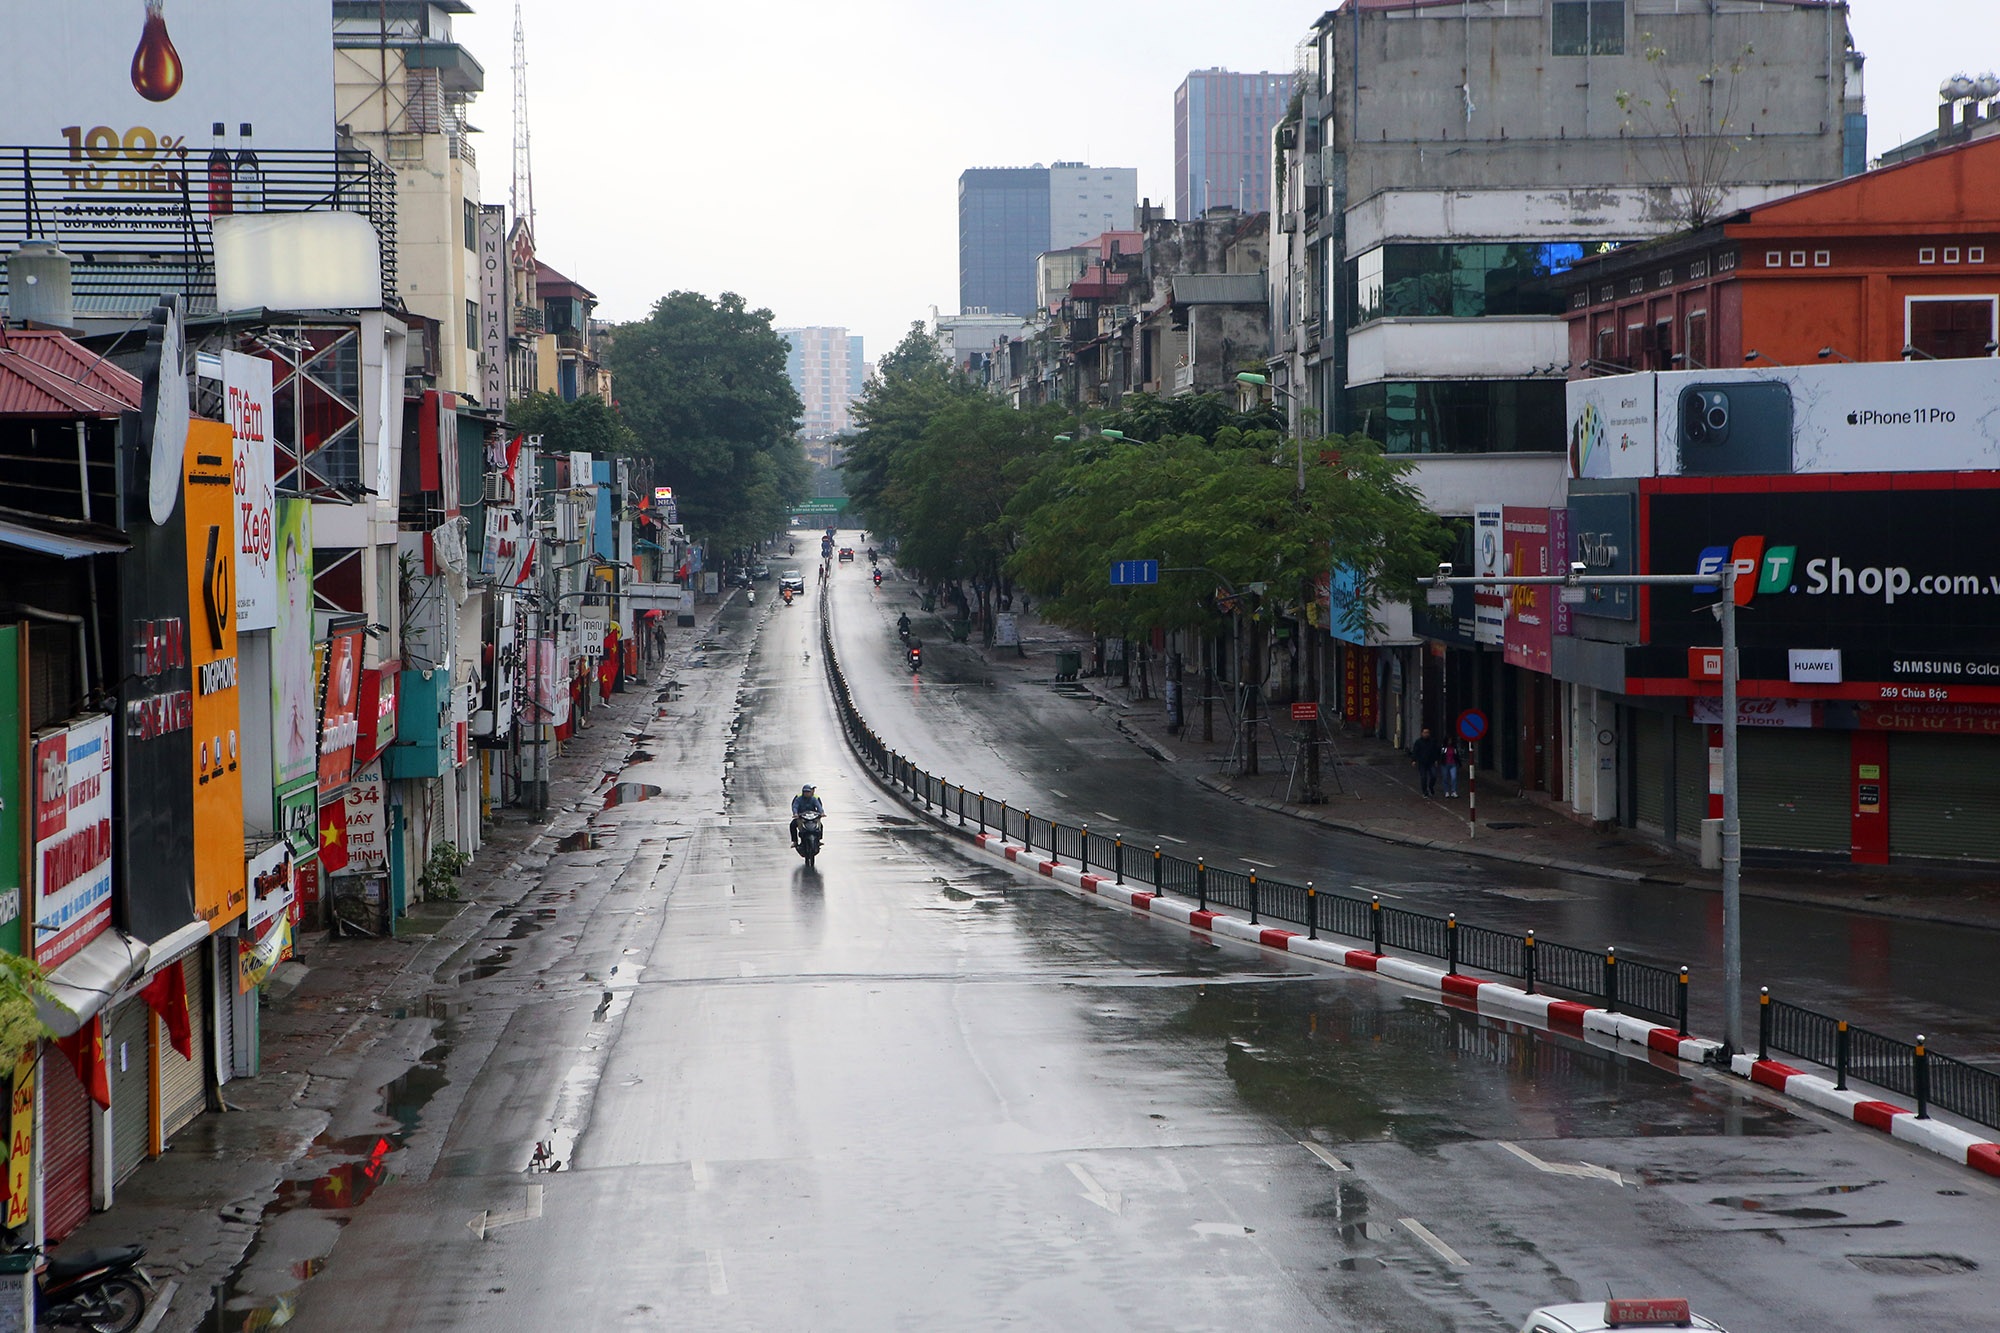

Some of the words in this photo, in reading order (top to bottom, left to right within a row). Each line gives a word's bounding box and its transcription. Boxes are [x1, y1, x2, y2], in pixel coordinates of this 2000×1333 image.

[61, 126, 189, 164] 100%
[229, 385, 264, 453] Tiệm
[1859, 410, 1911, 425] iPhone
[1913, 408, 1926, 423] 11
[1930, 408, 1956, 423] Pro
[1699, 556, 1789, 582] FPT
[583, 644, 602, 654] 104
[201, 656, 238, 696] DIGIPHONE
[1794, 662, 1834, 671] HUAWEI
[1893, 660, 1962, 674] SAMSUNG
[1881, 687, 1899, 697] 269
[1928, 687, 1948, 701] Bộc
[348, 785, 380, 805] 34
[9, 1192, 28, 1222] A4
